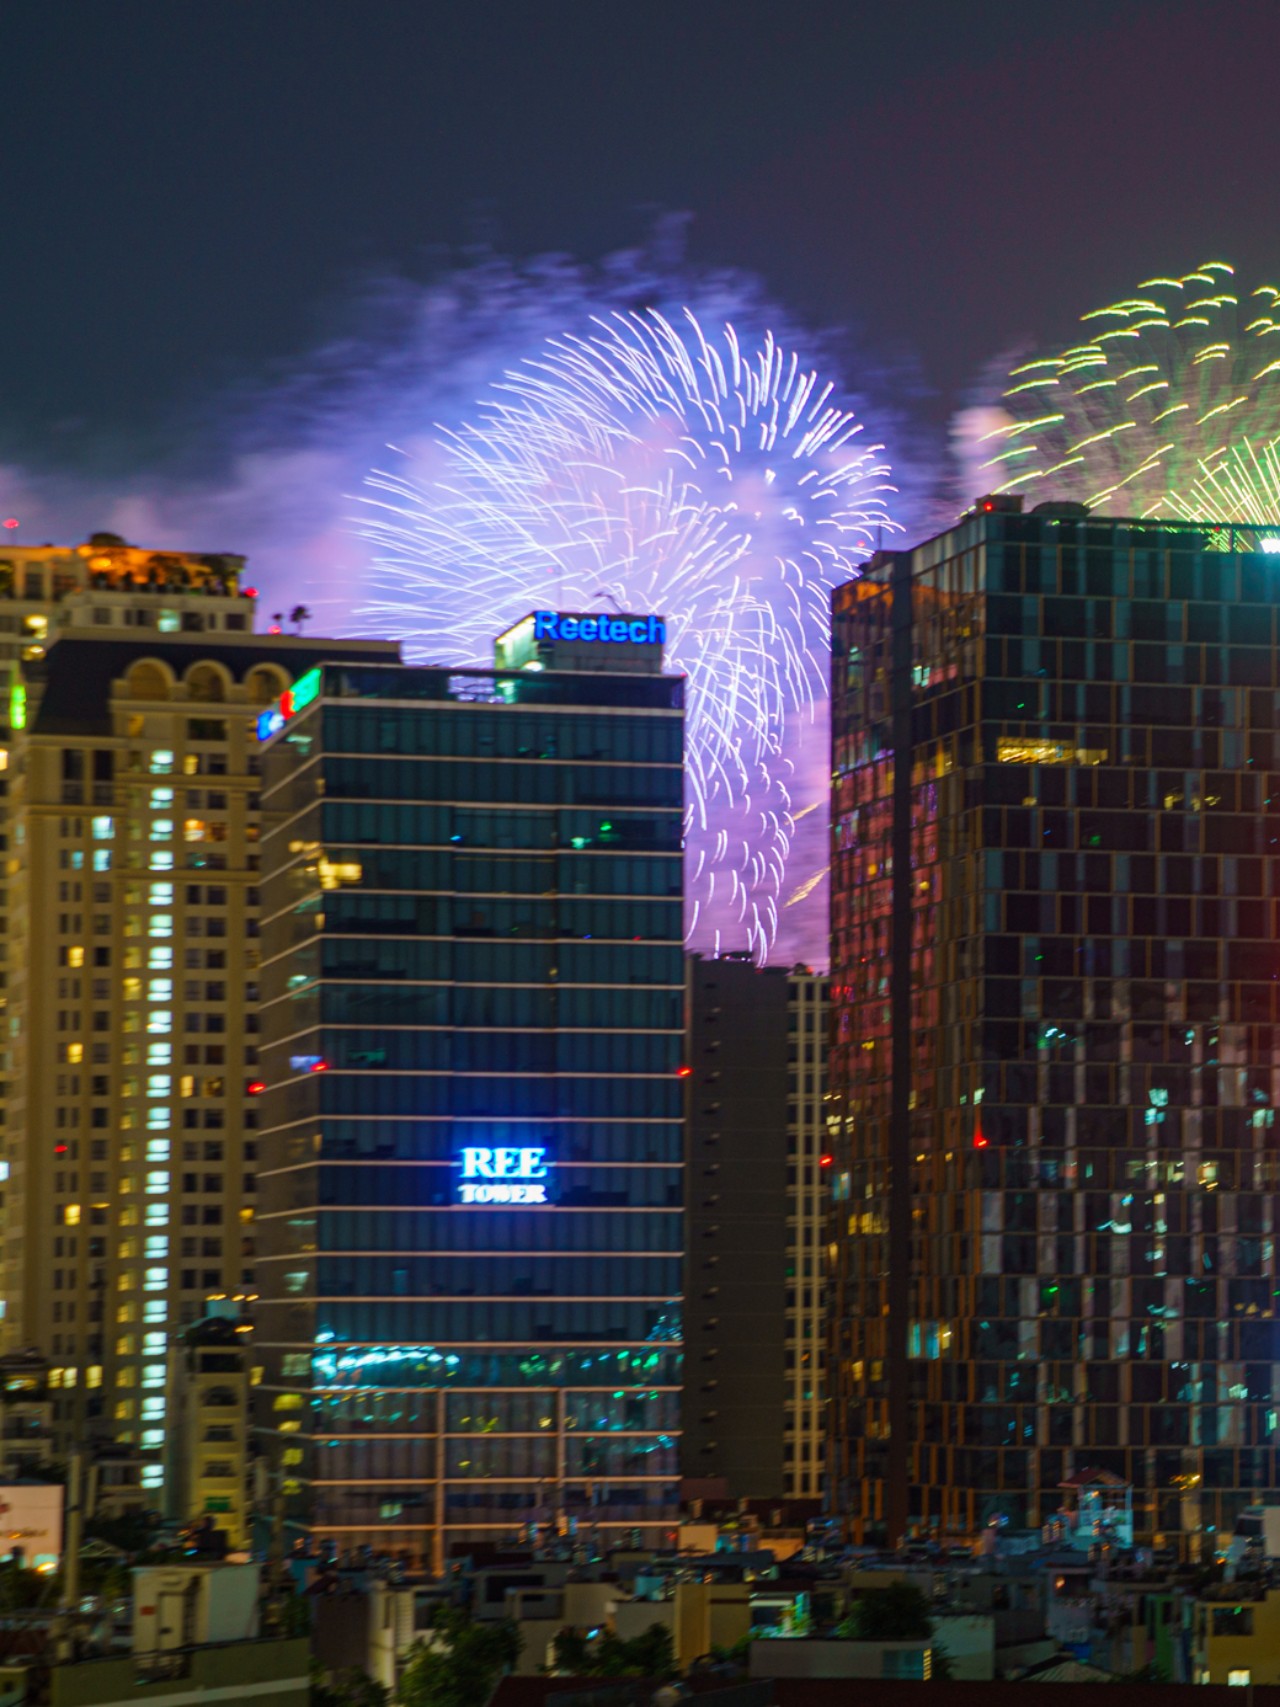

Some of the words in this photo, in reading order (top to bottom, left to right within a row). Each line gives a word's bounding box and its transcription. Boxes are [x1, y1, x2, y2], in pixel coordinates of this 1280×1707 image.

[534, 611, 666, 644] Reetech
[459, 1147, 547, 1178] REE
[457, 1184, 547, 1203] TOWER
